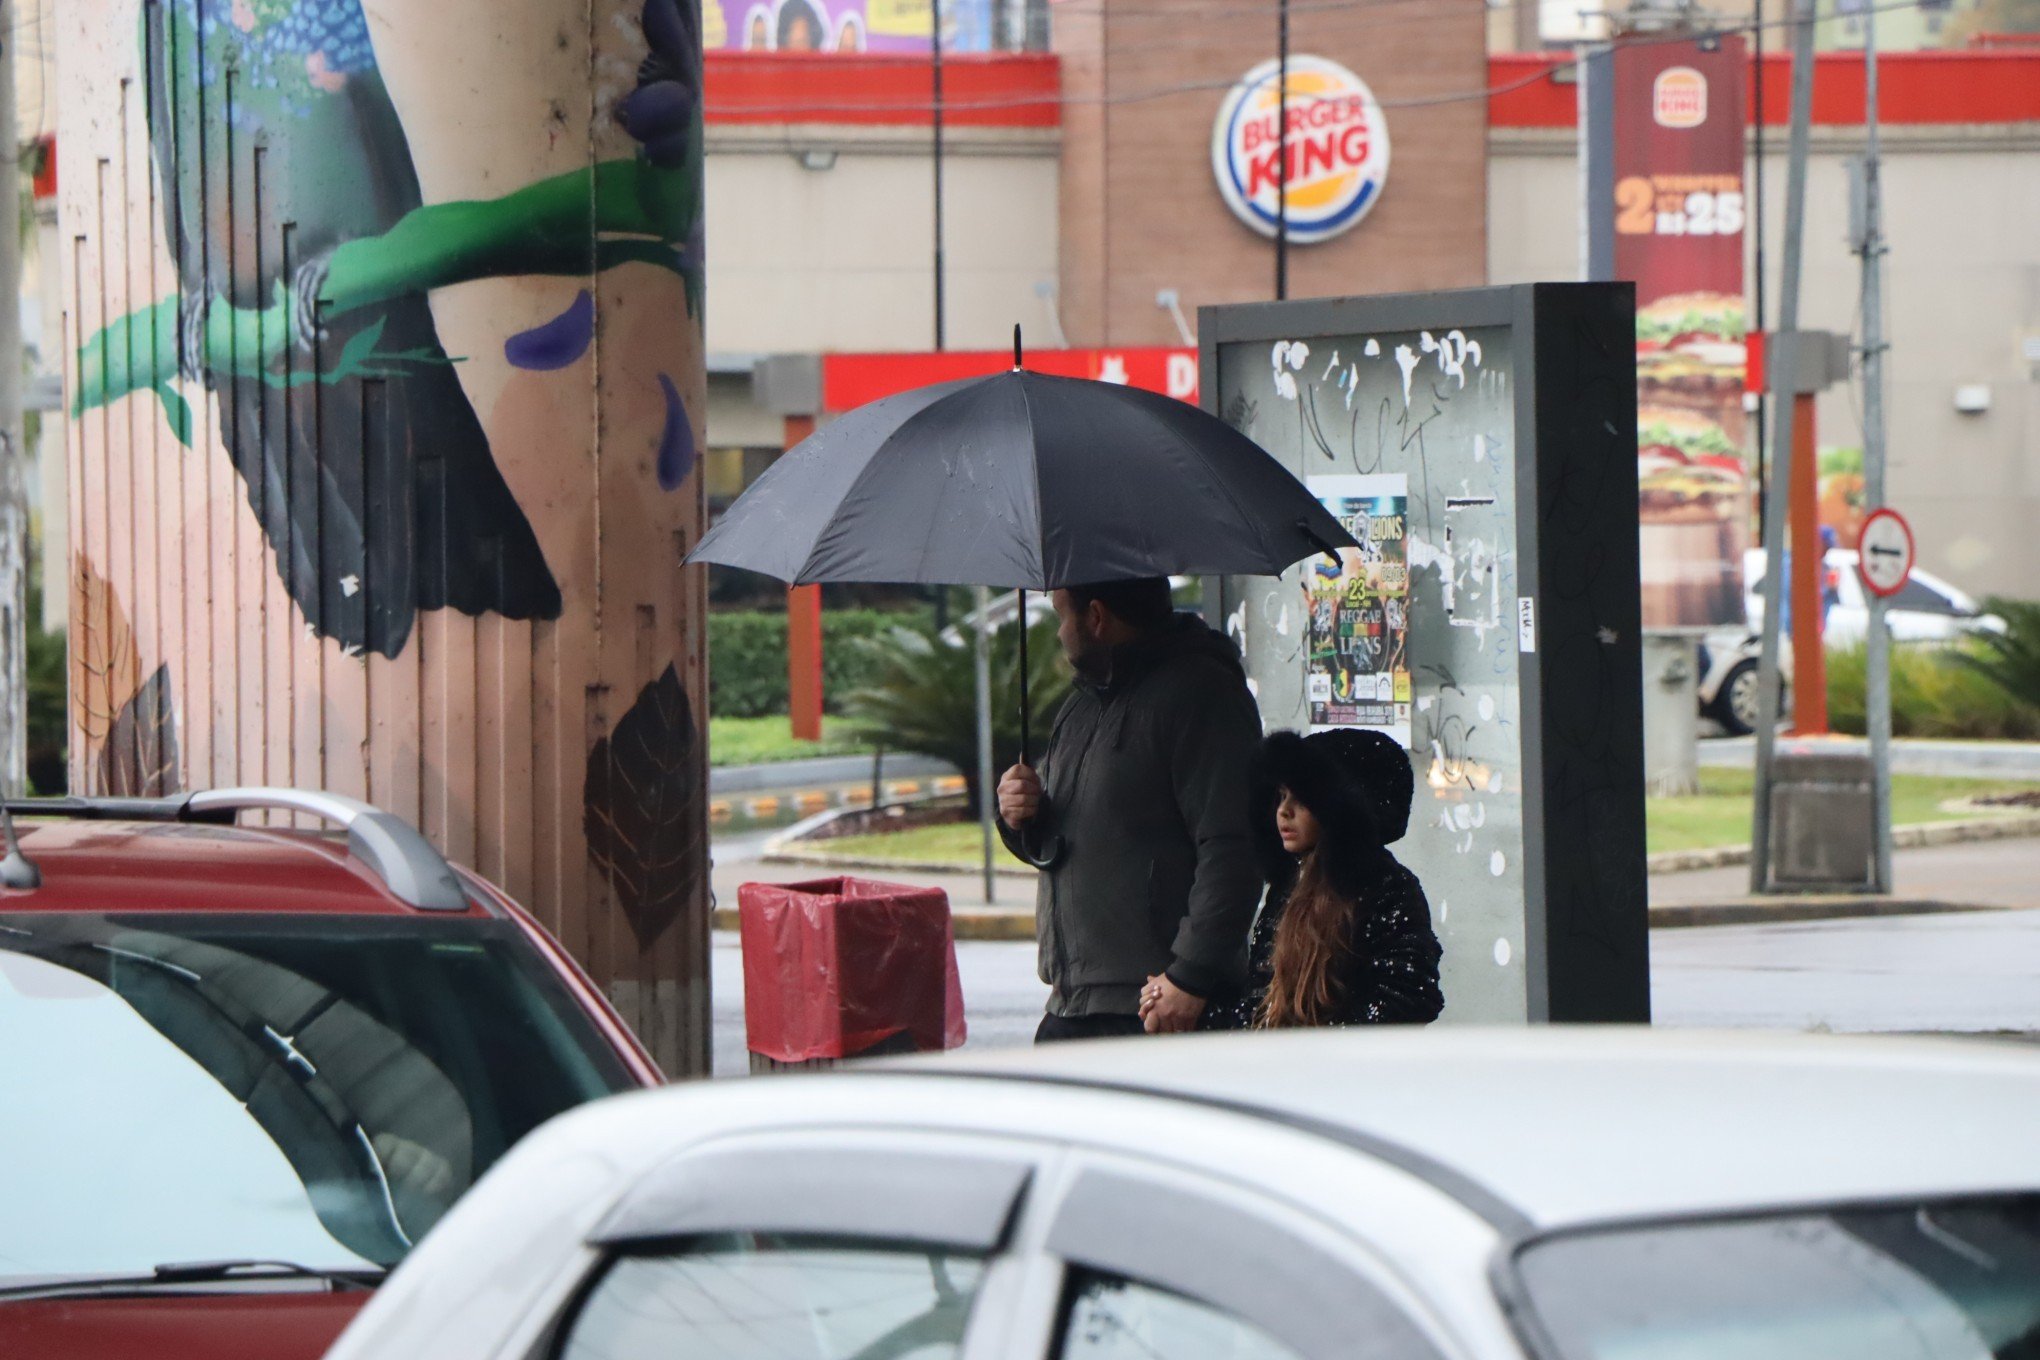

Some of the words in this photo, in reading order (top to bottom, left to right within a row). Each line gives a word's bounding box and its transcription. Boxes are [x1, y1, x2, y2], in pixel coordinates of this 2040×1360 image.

[1243, 94, 1365, 152] BURGER
[1247, 125, 1370, 199] KING
[1615, 176, 1655, 235] 2
[1340, 609, 1382, 623] REGGAE
[1340, 637, 1382, 655] LINS
